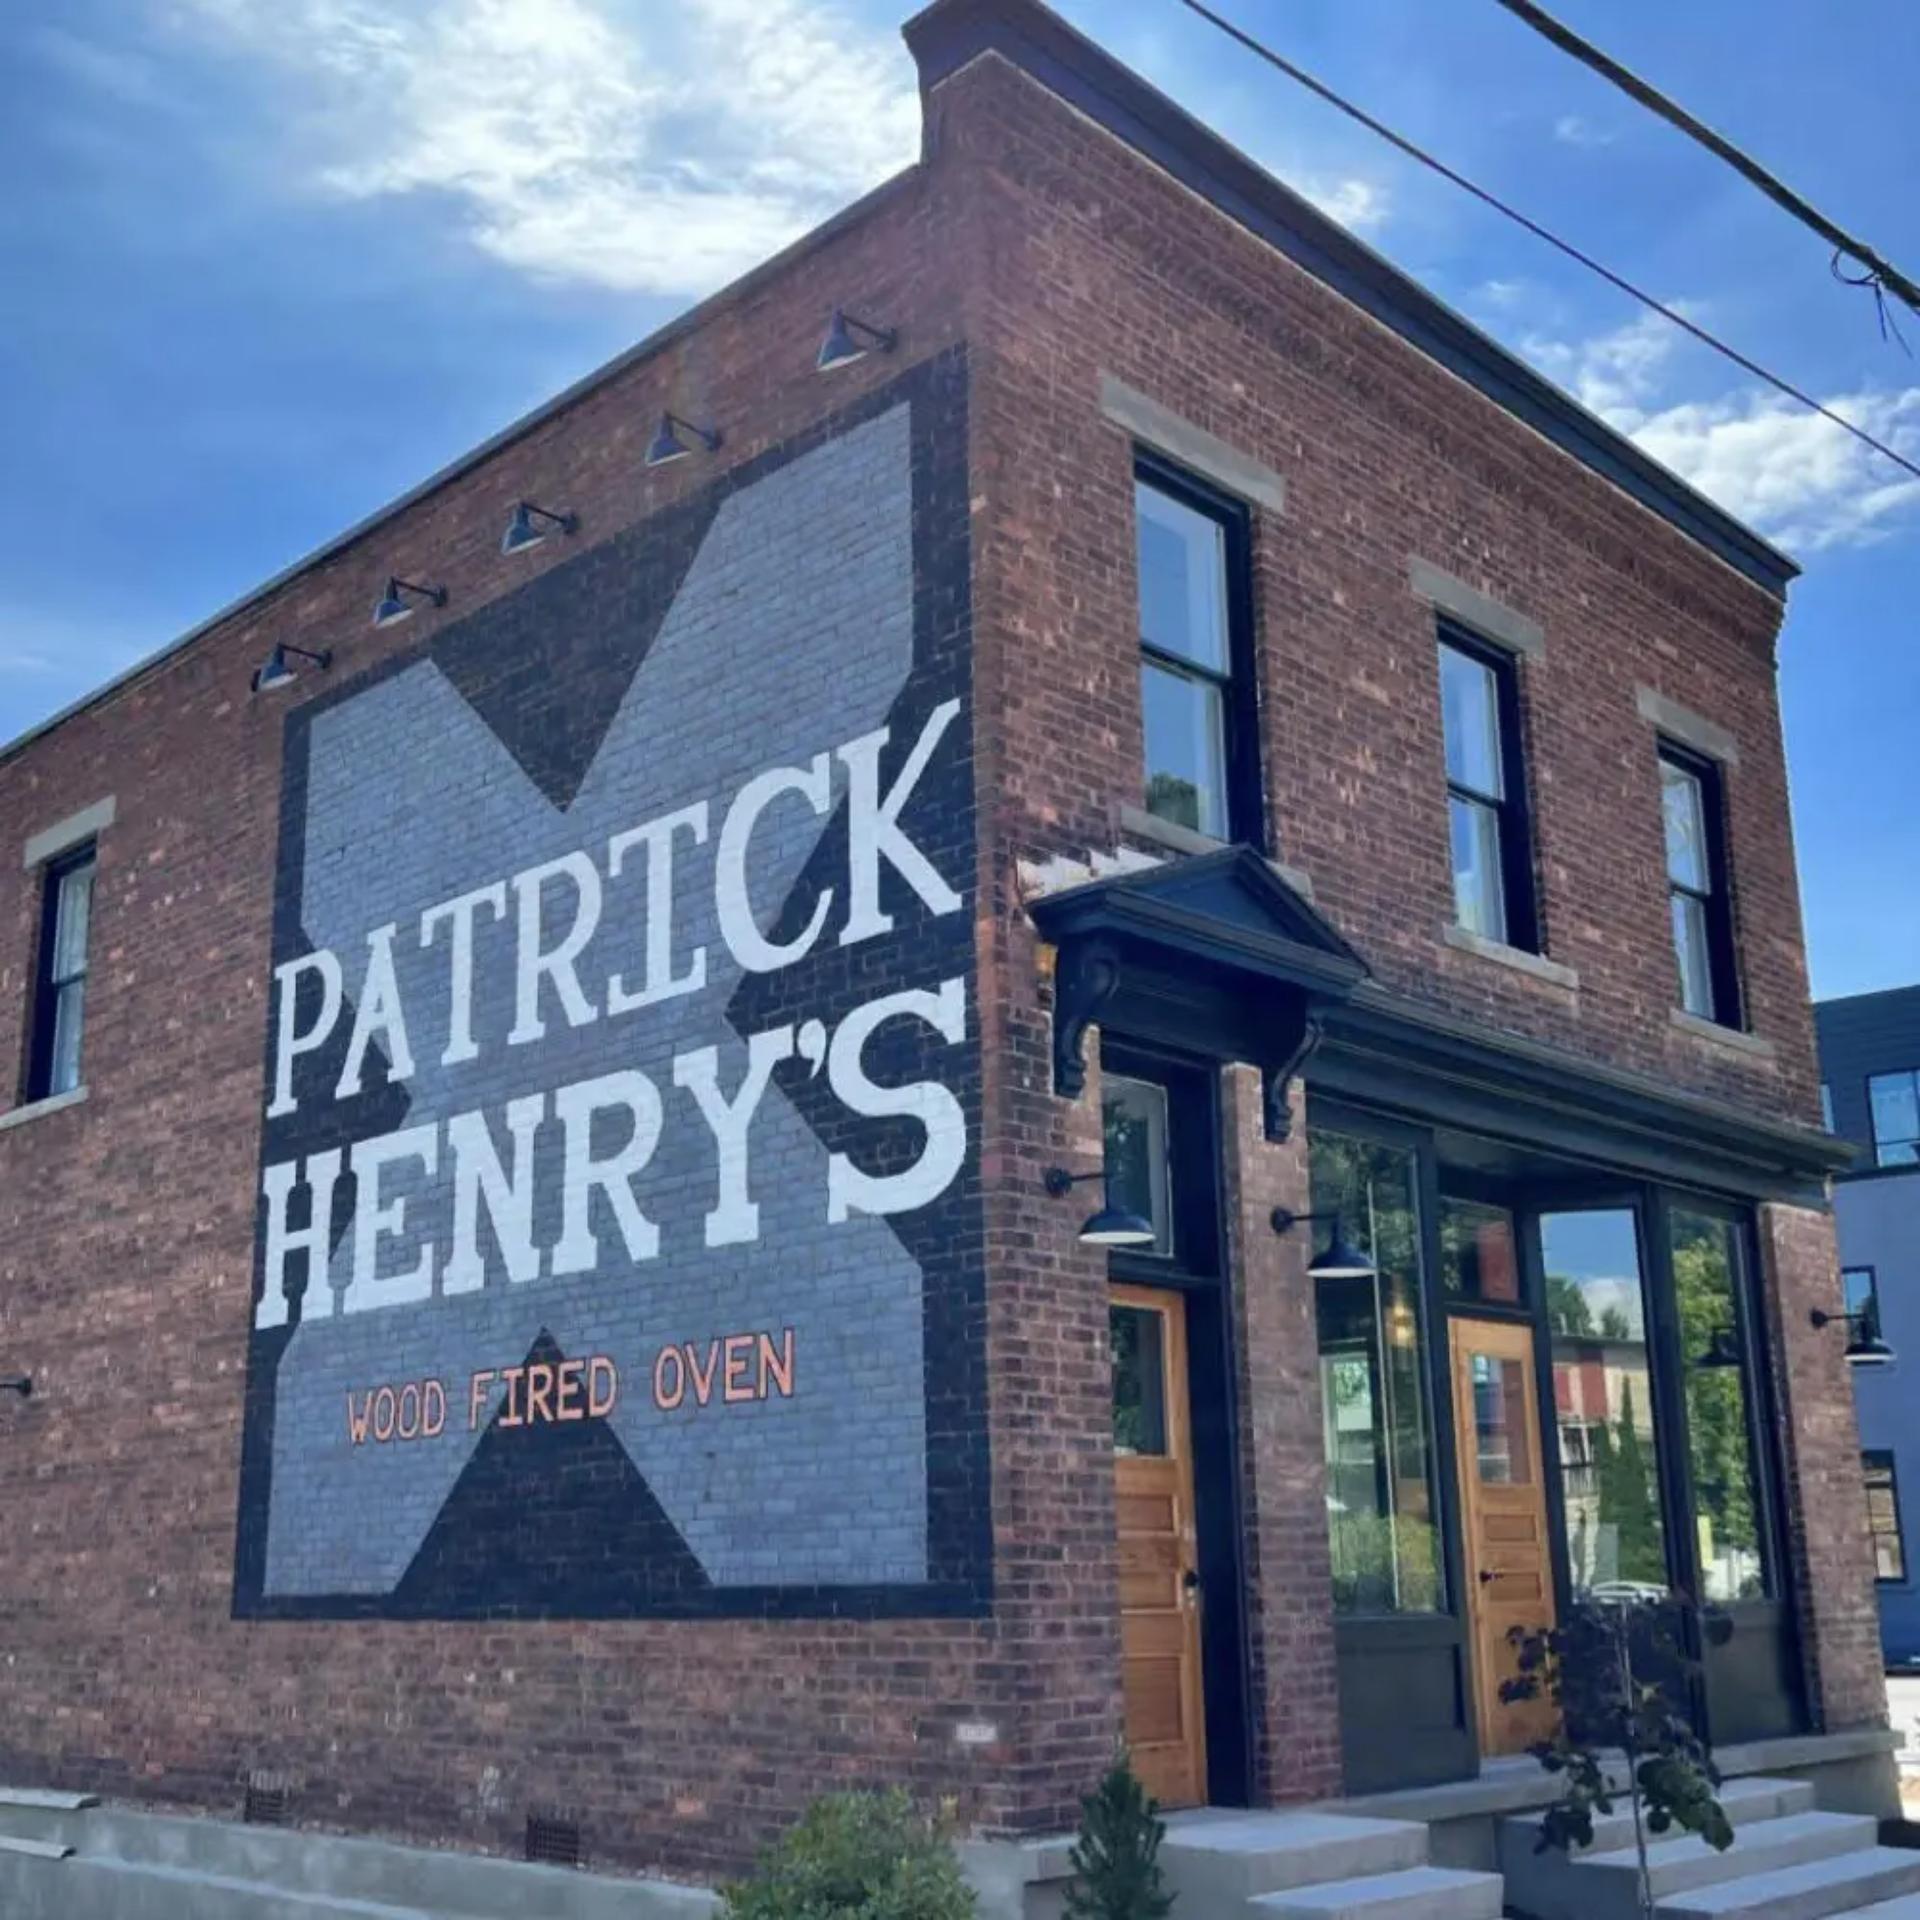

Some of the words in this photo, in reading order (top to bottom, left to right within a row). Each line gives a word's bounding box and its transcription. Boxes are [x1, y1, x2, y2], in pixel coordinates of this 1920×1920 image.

[266, 698, 963, 1120] PATRICK
[255, 977, 967, 1330] HENRY'S
[347, 1379, 446, 1446] WOOD
[468, 1355, 618, 1430] FIRED
[653, 1328, 796, 1411] OVEN
